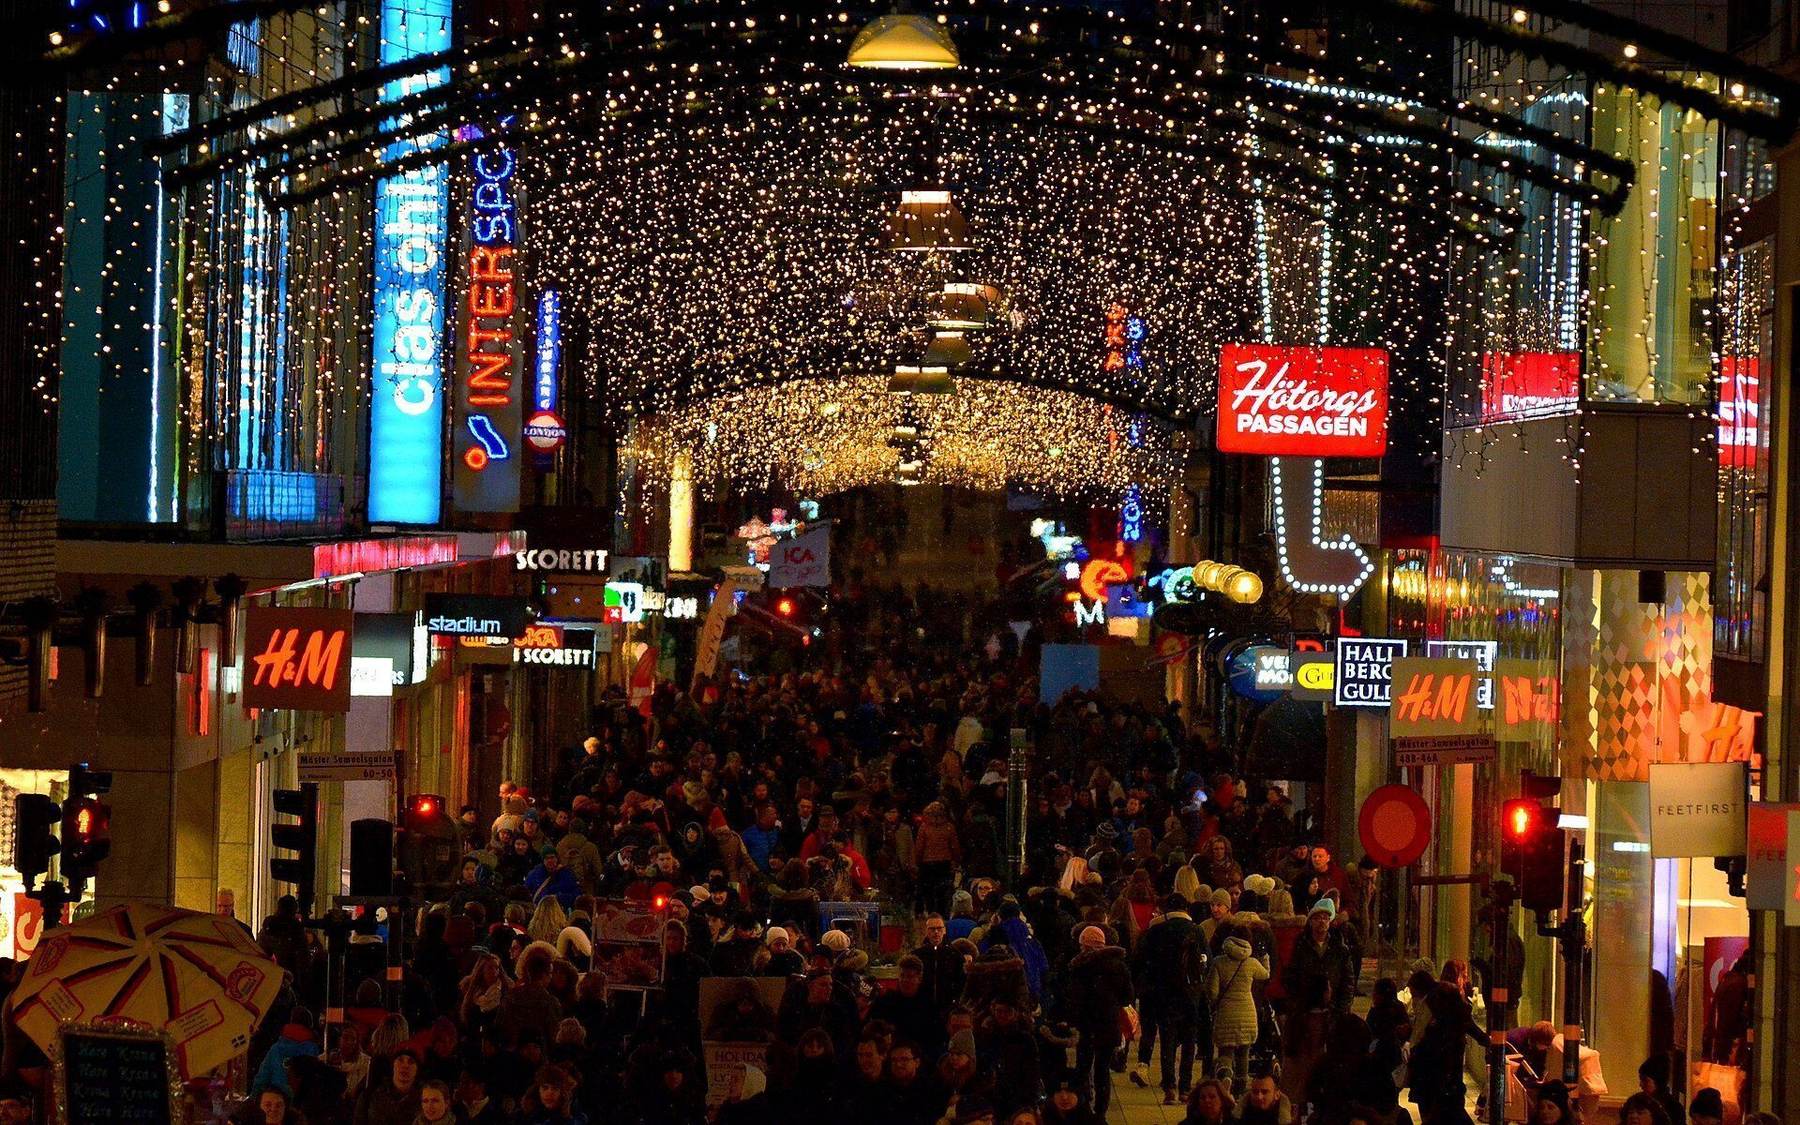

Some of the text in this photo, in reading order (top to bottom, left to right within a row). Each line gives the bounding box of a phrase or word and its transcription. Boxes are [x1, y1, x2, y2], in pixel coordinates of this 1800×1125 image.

[381, 288, 436, 415] clas
[1232, 359, 1378, 417] Hötorgs
[1237, 413, 1367, 437] PASSAGEN
[515, 549, 608, 571] SCORETT
[784, 547, 815, 564] ICA
[428, 615, 501, 633] stadium
[253, 629, 345, 690] H&M
[523, 648, 593, 665] SCORETT
[1396, 673, 1472, 724] H&M
[1657, 802, 1740, 817] FEETFIRST
